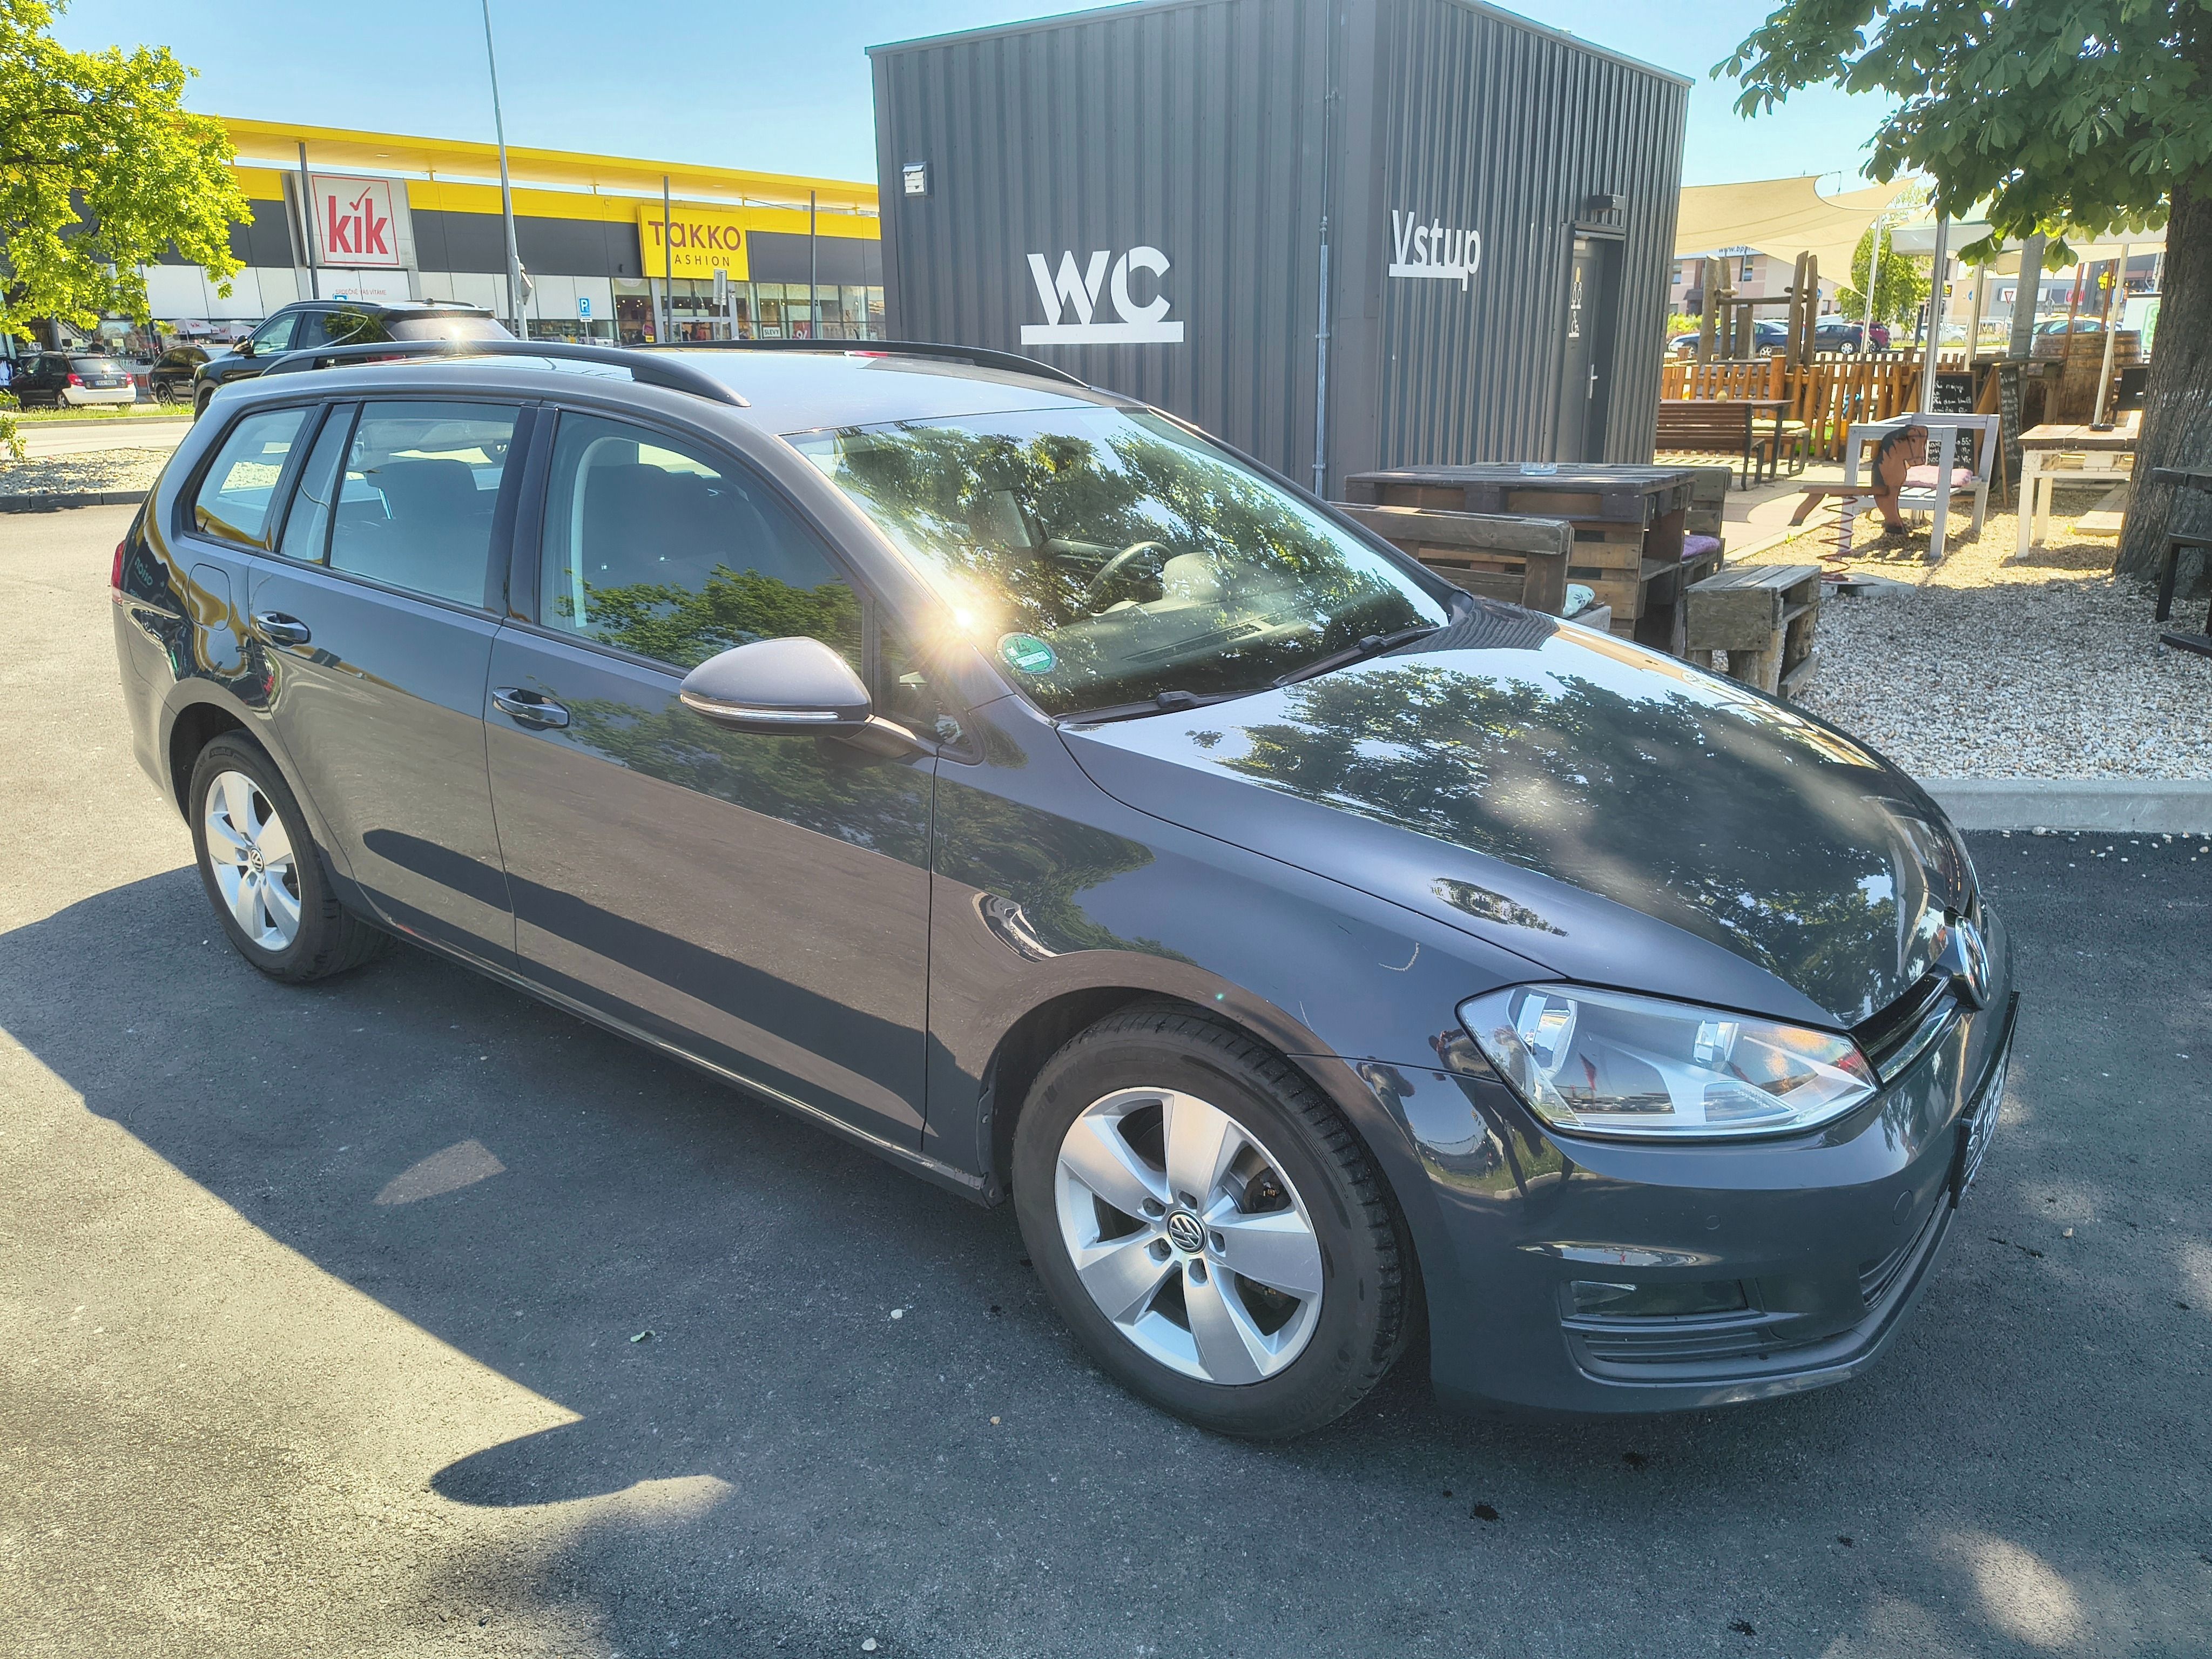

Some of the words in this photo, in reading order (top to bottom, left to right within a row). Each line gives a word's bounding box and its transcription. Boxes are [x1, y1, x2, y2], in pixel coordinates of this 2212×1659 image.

[328, 187, 389, 254] kik
[1391, 210, 1481, 291] Vstup
[674, 254, 730, 267] ASHION
[1027, 246, 1171, 326] WC
[581, 299, 588, 312] P
